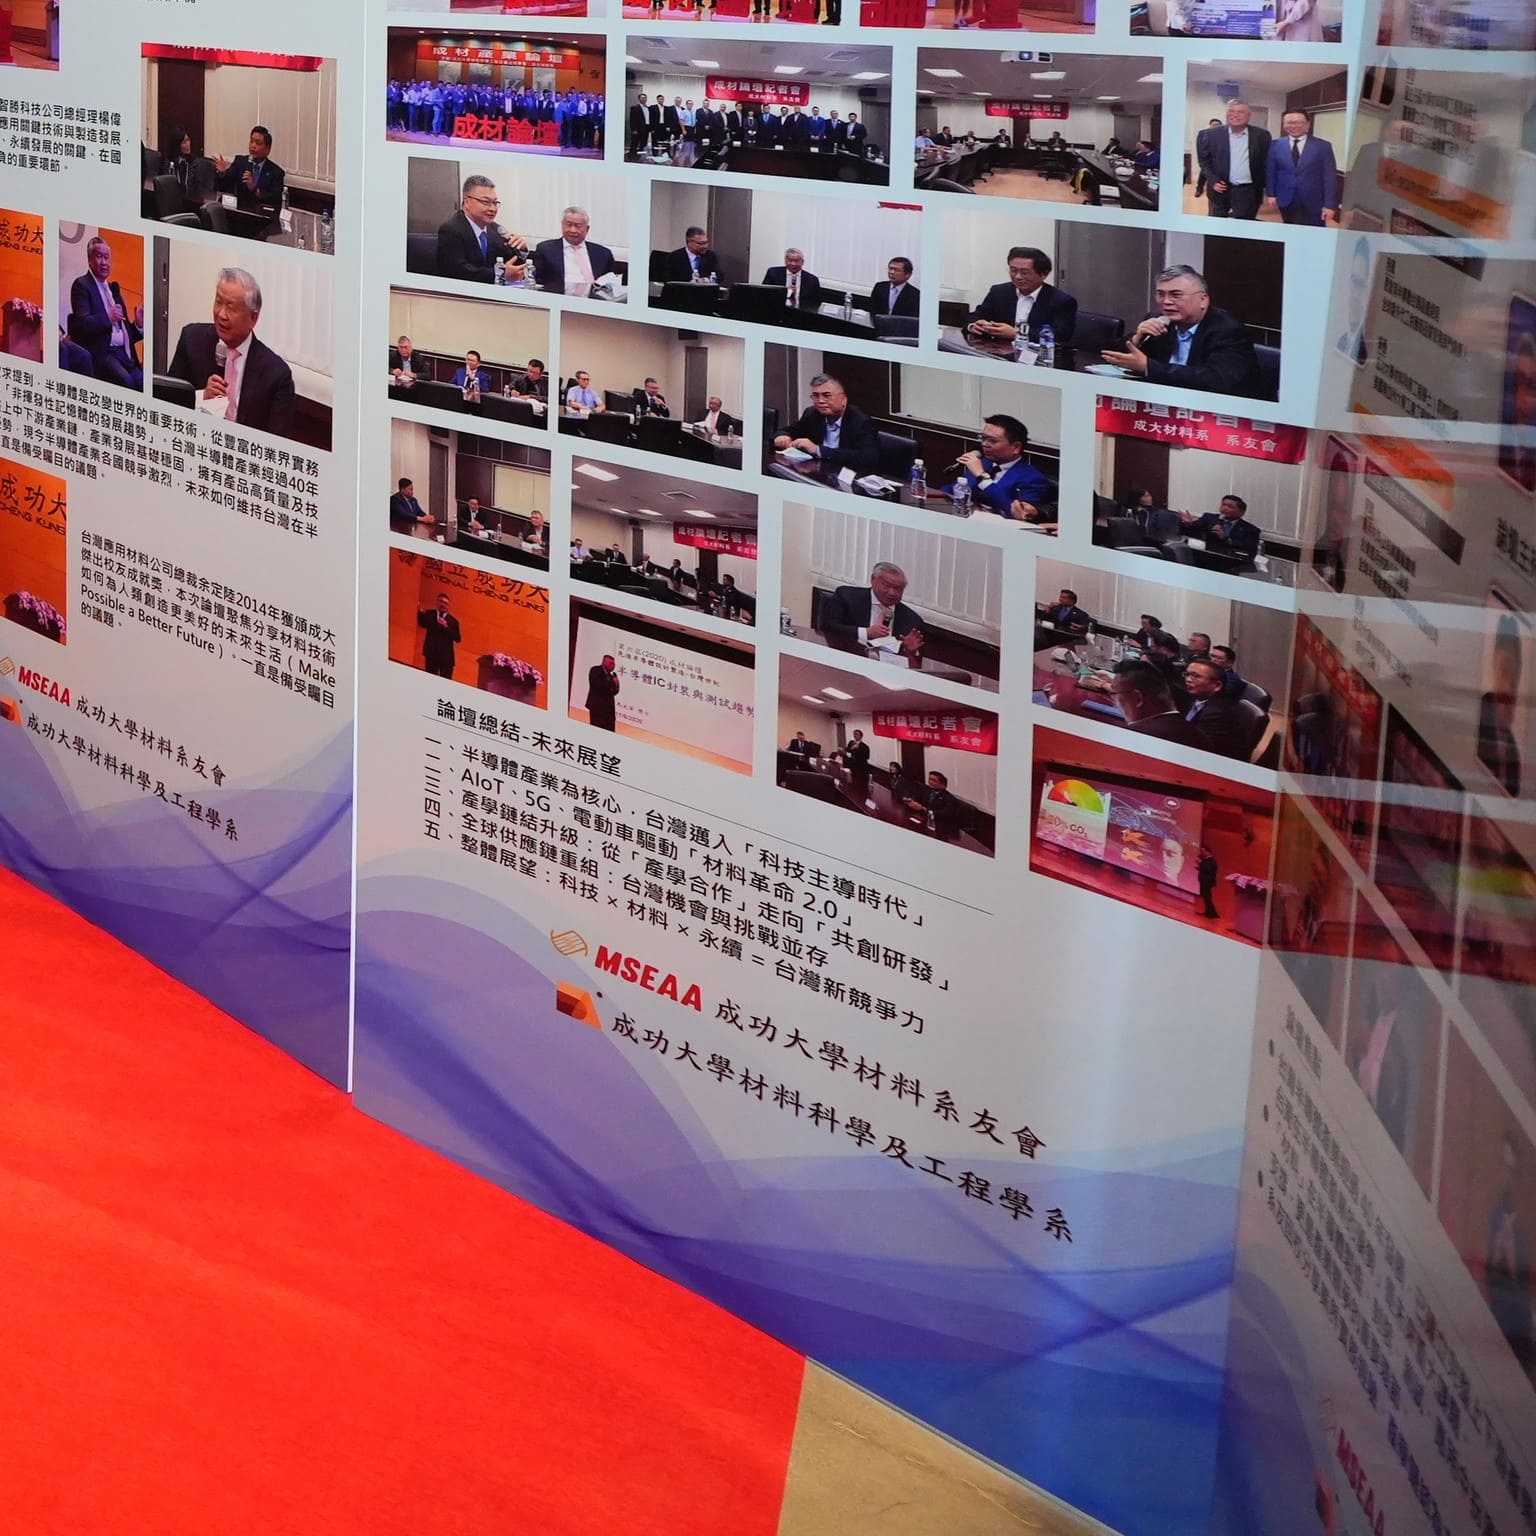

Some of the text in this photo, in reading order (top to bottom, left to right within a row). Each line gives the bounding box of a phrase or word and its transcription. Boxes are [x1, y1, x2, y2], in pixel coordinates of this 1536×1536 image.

[433, 46, 563, 64] 成材產業論壇
[453, 113, 562, 147] 成材論壇
[1132, 418, 1278, 453] 成大材料系 系友會
[81, 530, 336, 648] 台灣應用材料公司總裁余定陸2014年獲頒成大
[81, 584, 125, 615] Possible
[138, 610, 174, 637] Better
[81, 601, 124, 630] 的議題。
[18, 664, 227, 788] MSEAA 成功大學材料系友會
[436, 698, 622, 777] 論壇總結-未來展望
[27, 713, 240, 843] 成功大學材料科學及工程學系
[774, 956, 925, 1035] 台灣新競爭力
[594, 944, 1047, 1159] MSEAA 成功大學材料系友會
[612, 1011, 1074, 1244] 成功大學材料科學及工程學系
